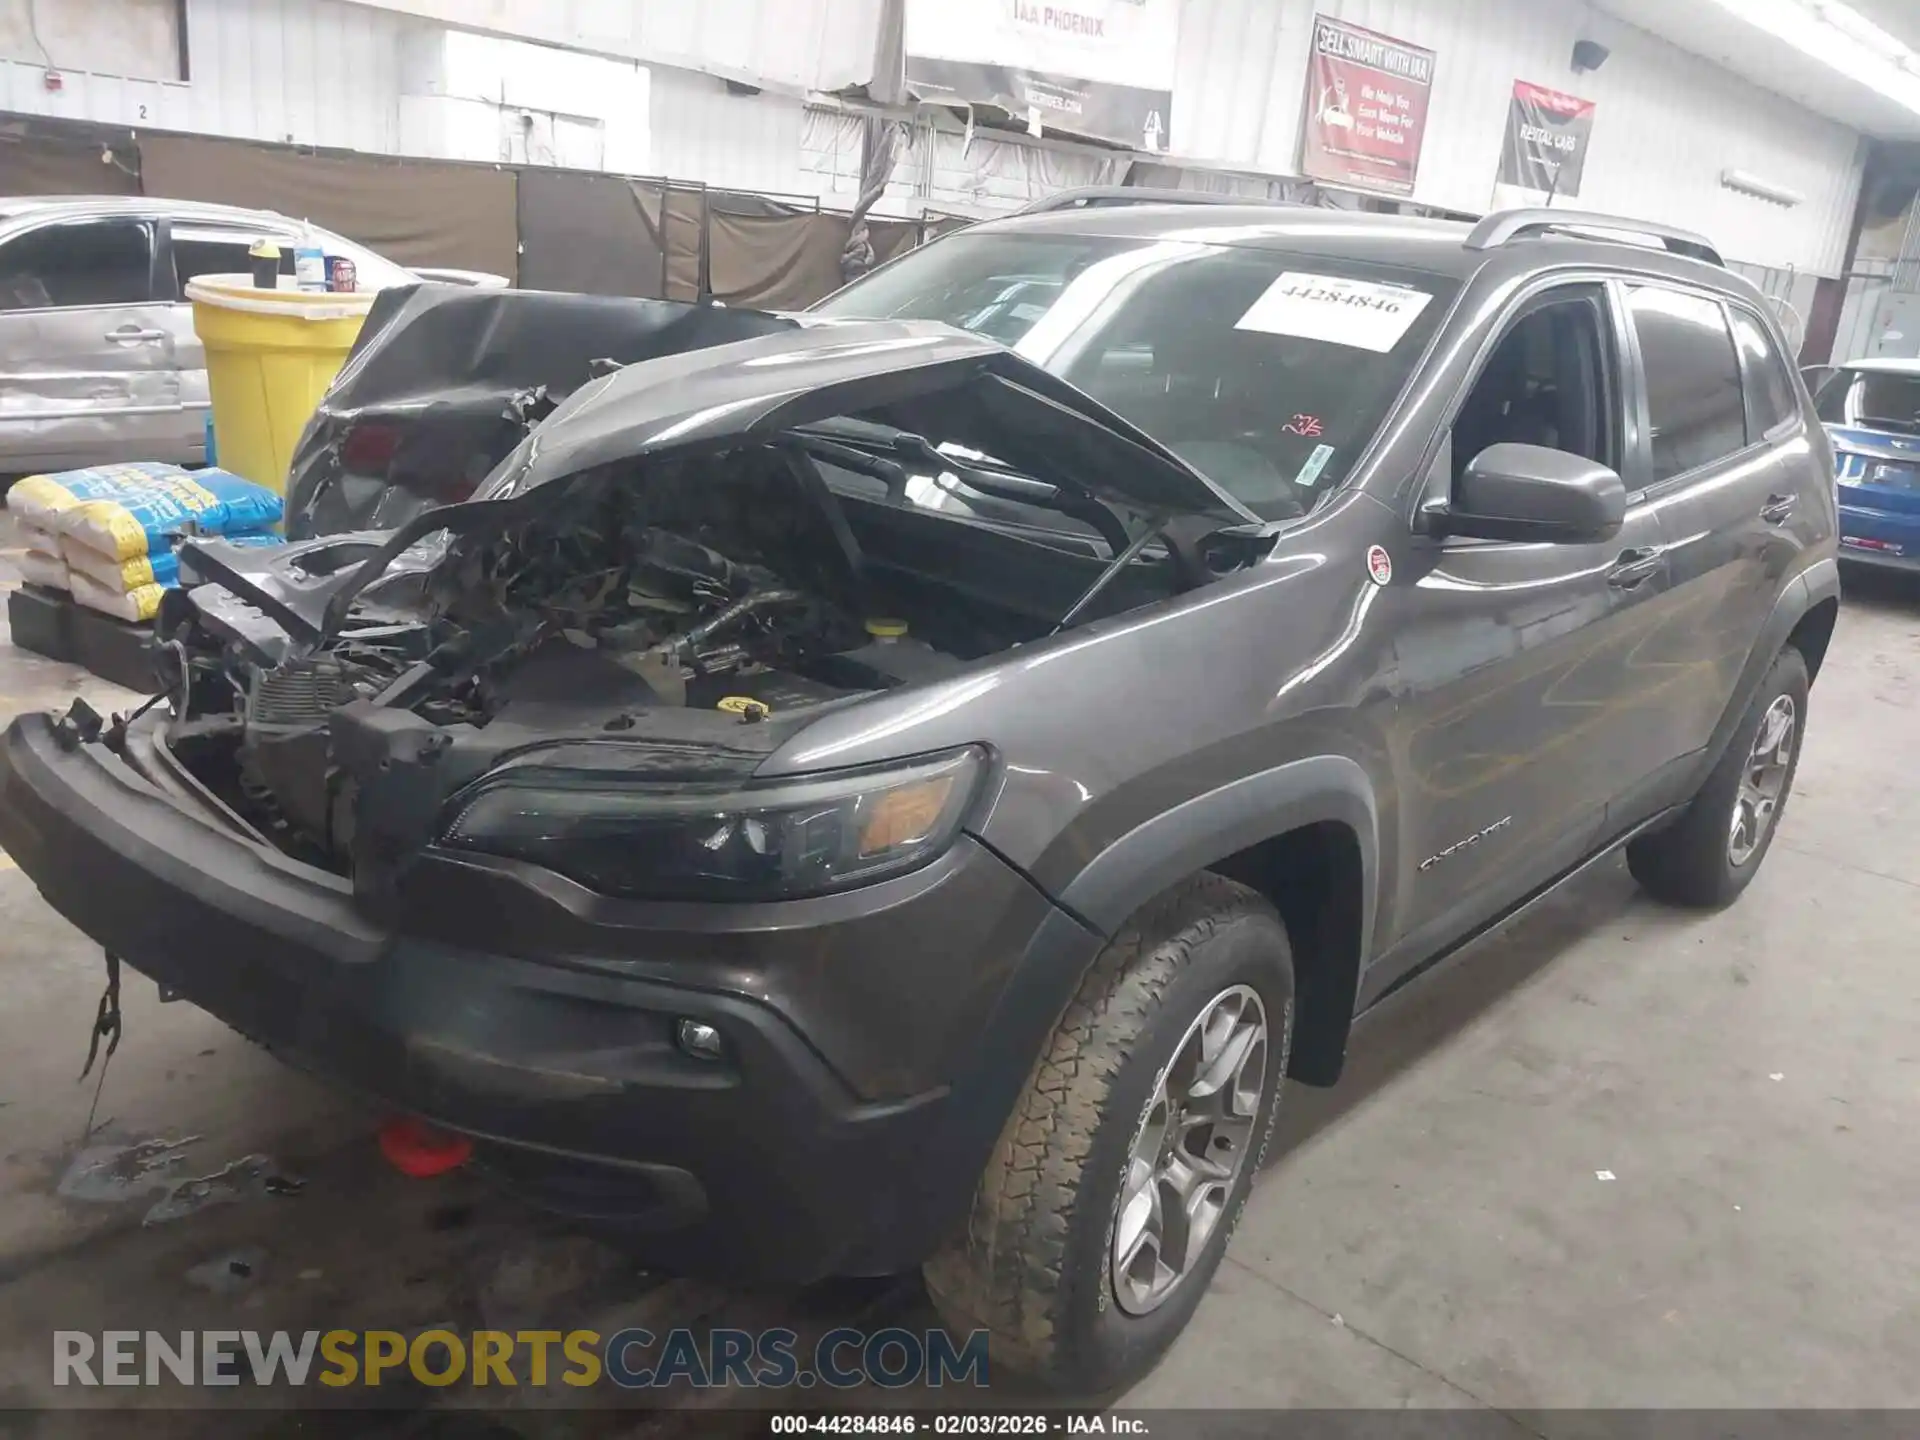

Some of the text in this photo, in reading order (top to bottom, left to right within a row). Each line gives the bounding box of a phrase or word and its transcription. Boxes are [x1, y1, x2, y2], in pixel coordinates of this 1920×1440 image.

[1044, 6, 1105, 37] PHOENIX
[1320, 28, 1347, 54] SELL
[1347, 39, 1384, 65] SMART
[1384, 50, 1410, 72] WITH
[139, 104, 147, 120] 2
[1520, 124, 1553, 146] RENTAL
[1281, 285, 1401, 315] 44284846
